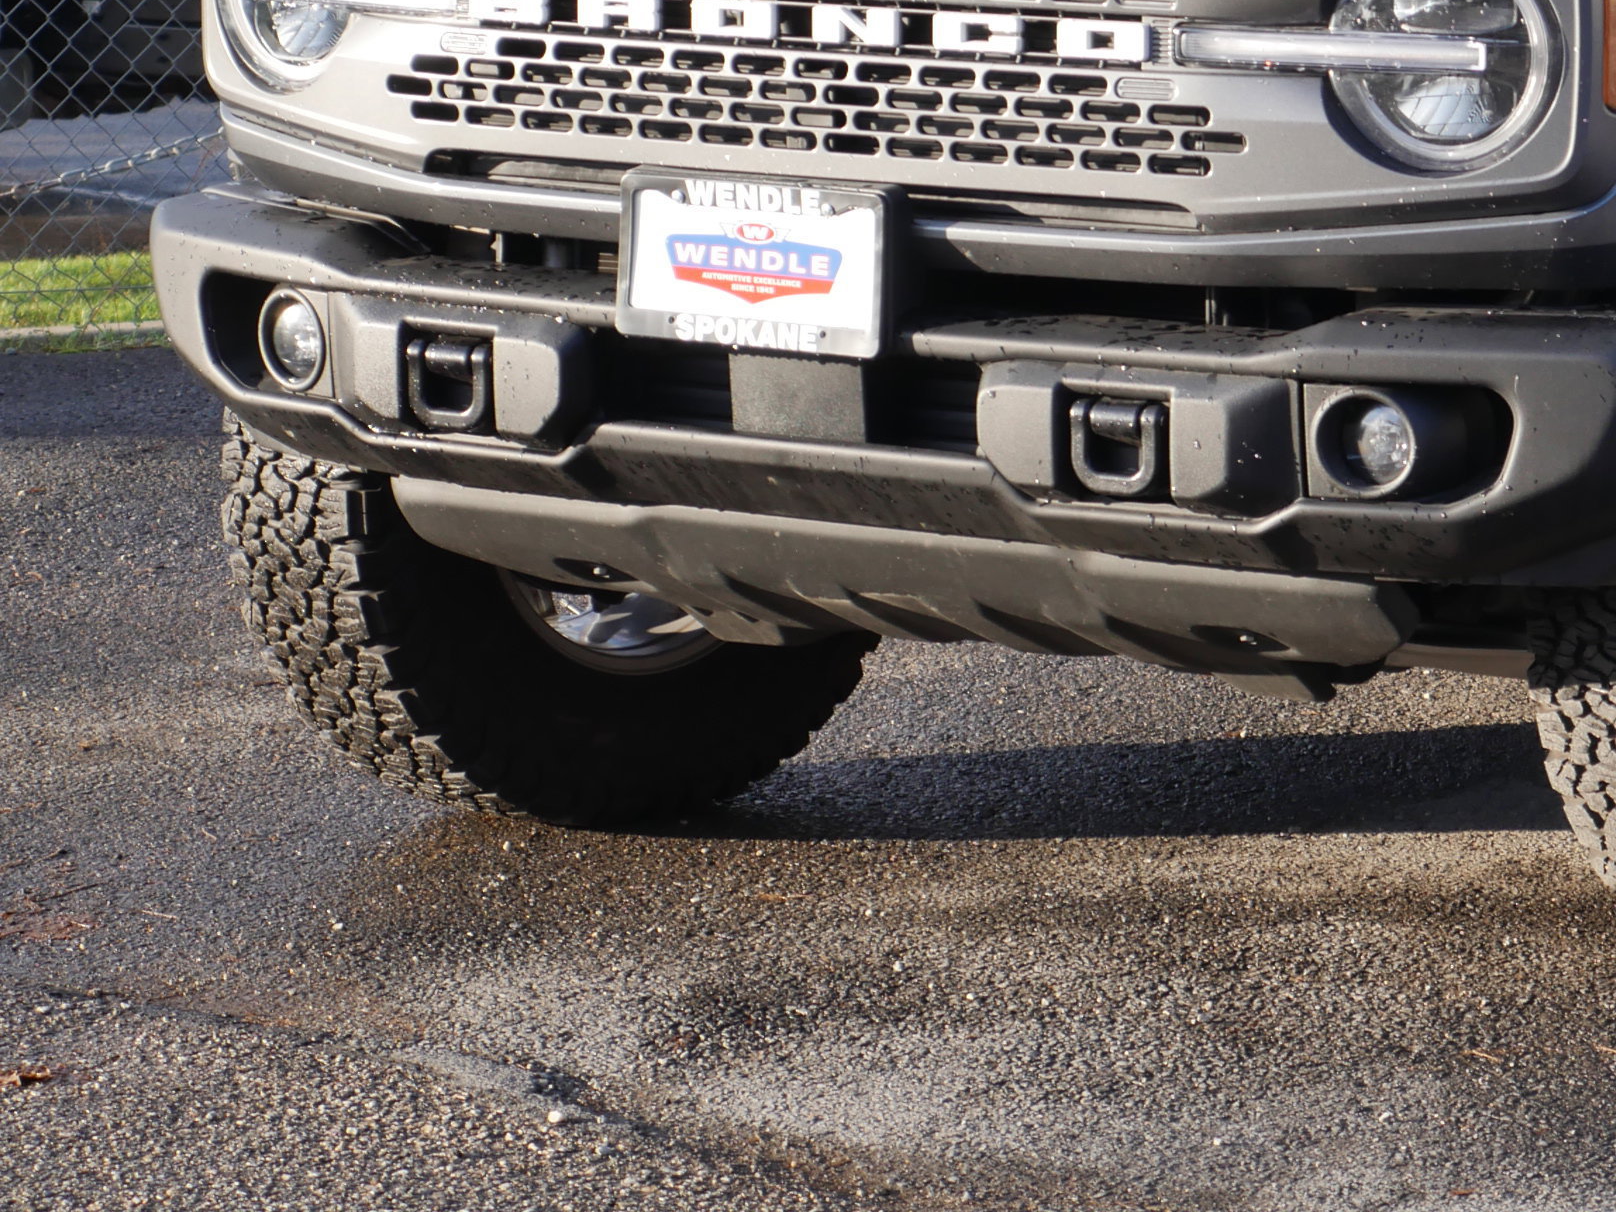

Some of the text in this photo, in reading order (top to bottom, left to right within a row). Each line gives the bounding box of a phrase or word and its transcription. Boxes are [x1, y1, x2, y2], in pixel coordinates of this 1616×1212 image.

[684, 179, 821, 216] WENDLE
[674, 242, 830, 277] WENDLE
[675, 314, 819, 351] SPOKANE
